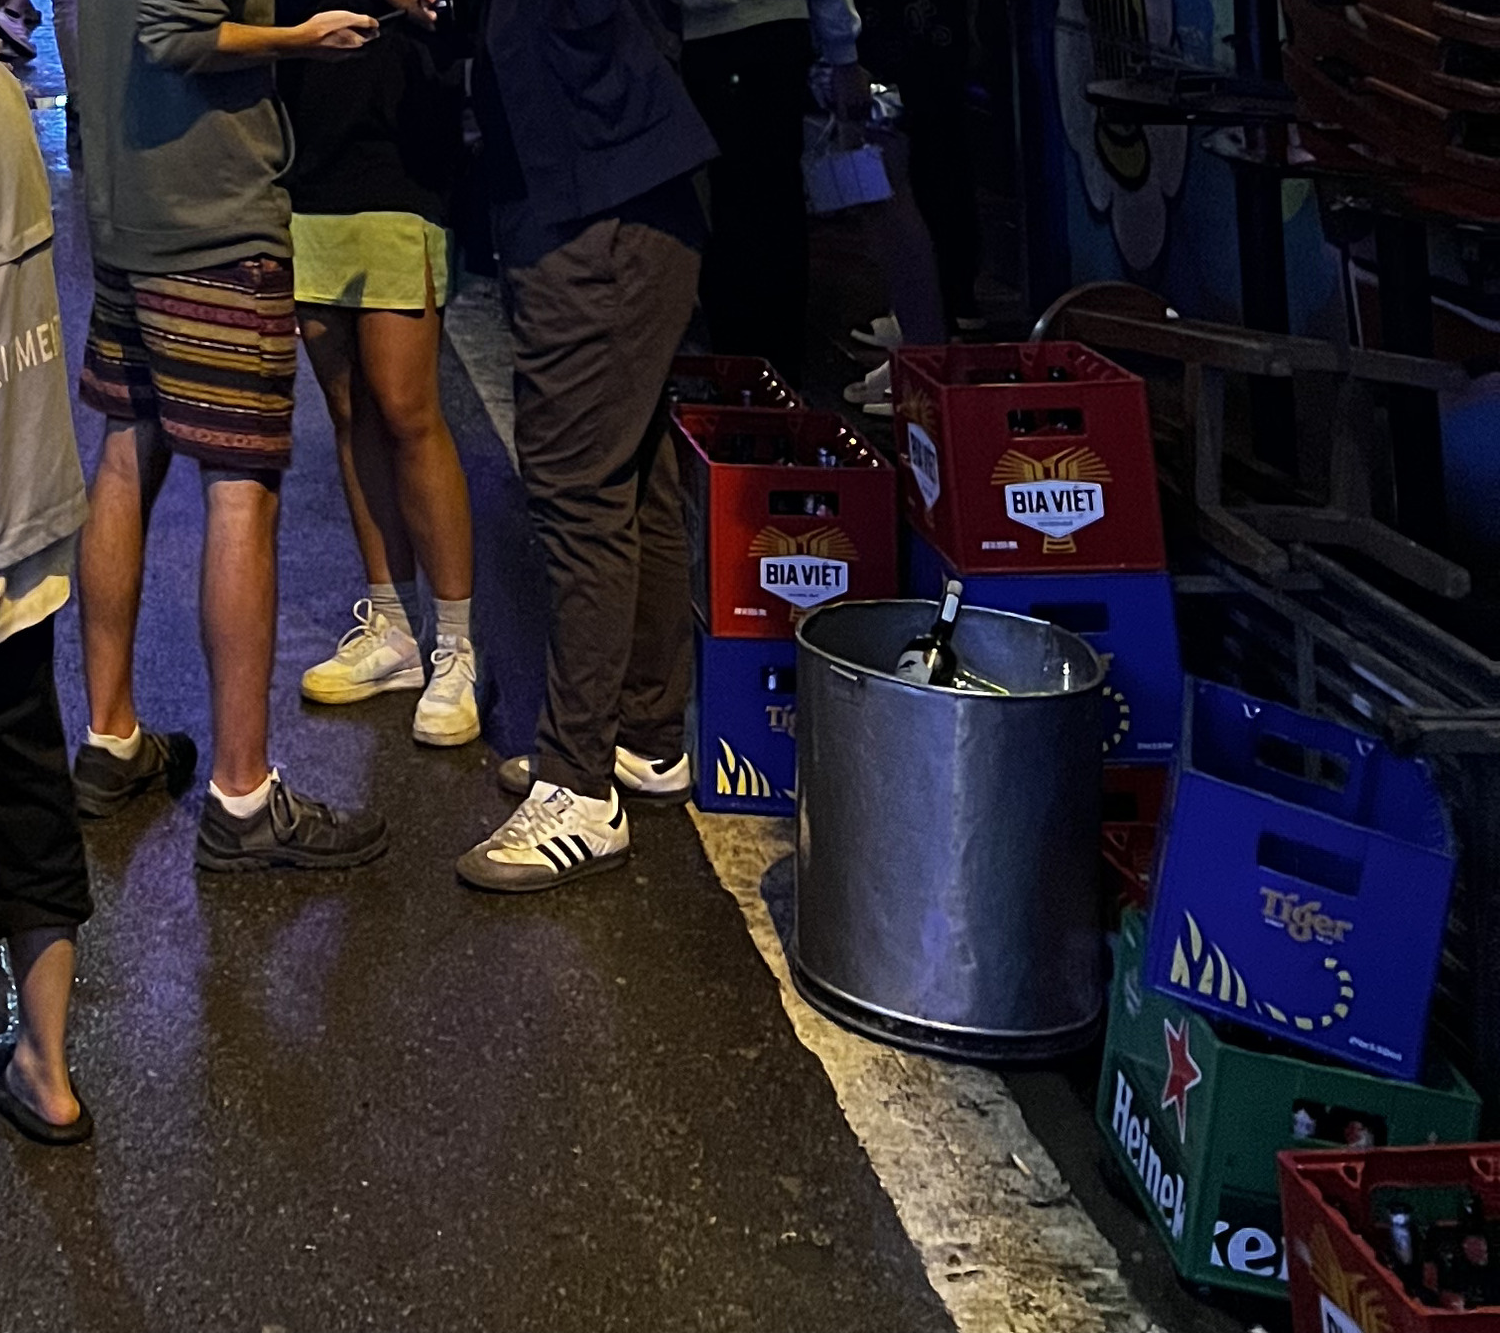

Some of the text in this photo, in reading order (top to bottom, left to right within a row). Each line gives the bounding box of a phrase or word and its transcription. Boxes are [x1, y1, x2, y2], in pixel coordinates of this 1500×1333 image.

[1012, 490, 1049, 514] BIA
[765, 563, 799, 586] BIA
[1259, 886, 1354, 943] Tiger
